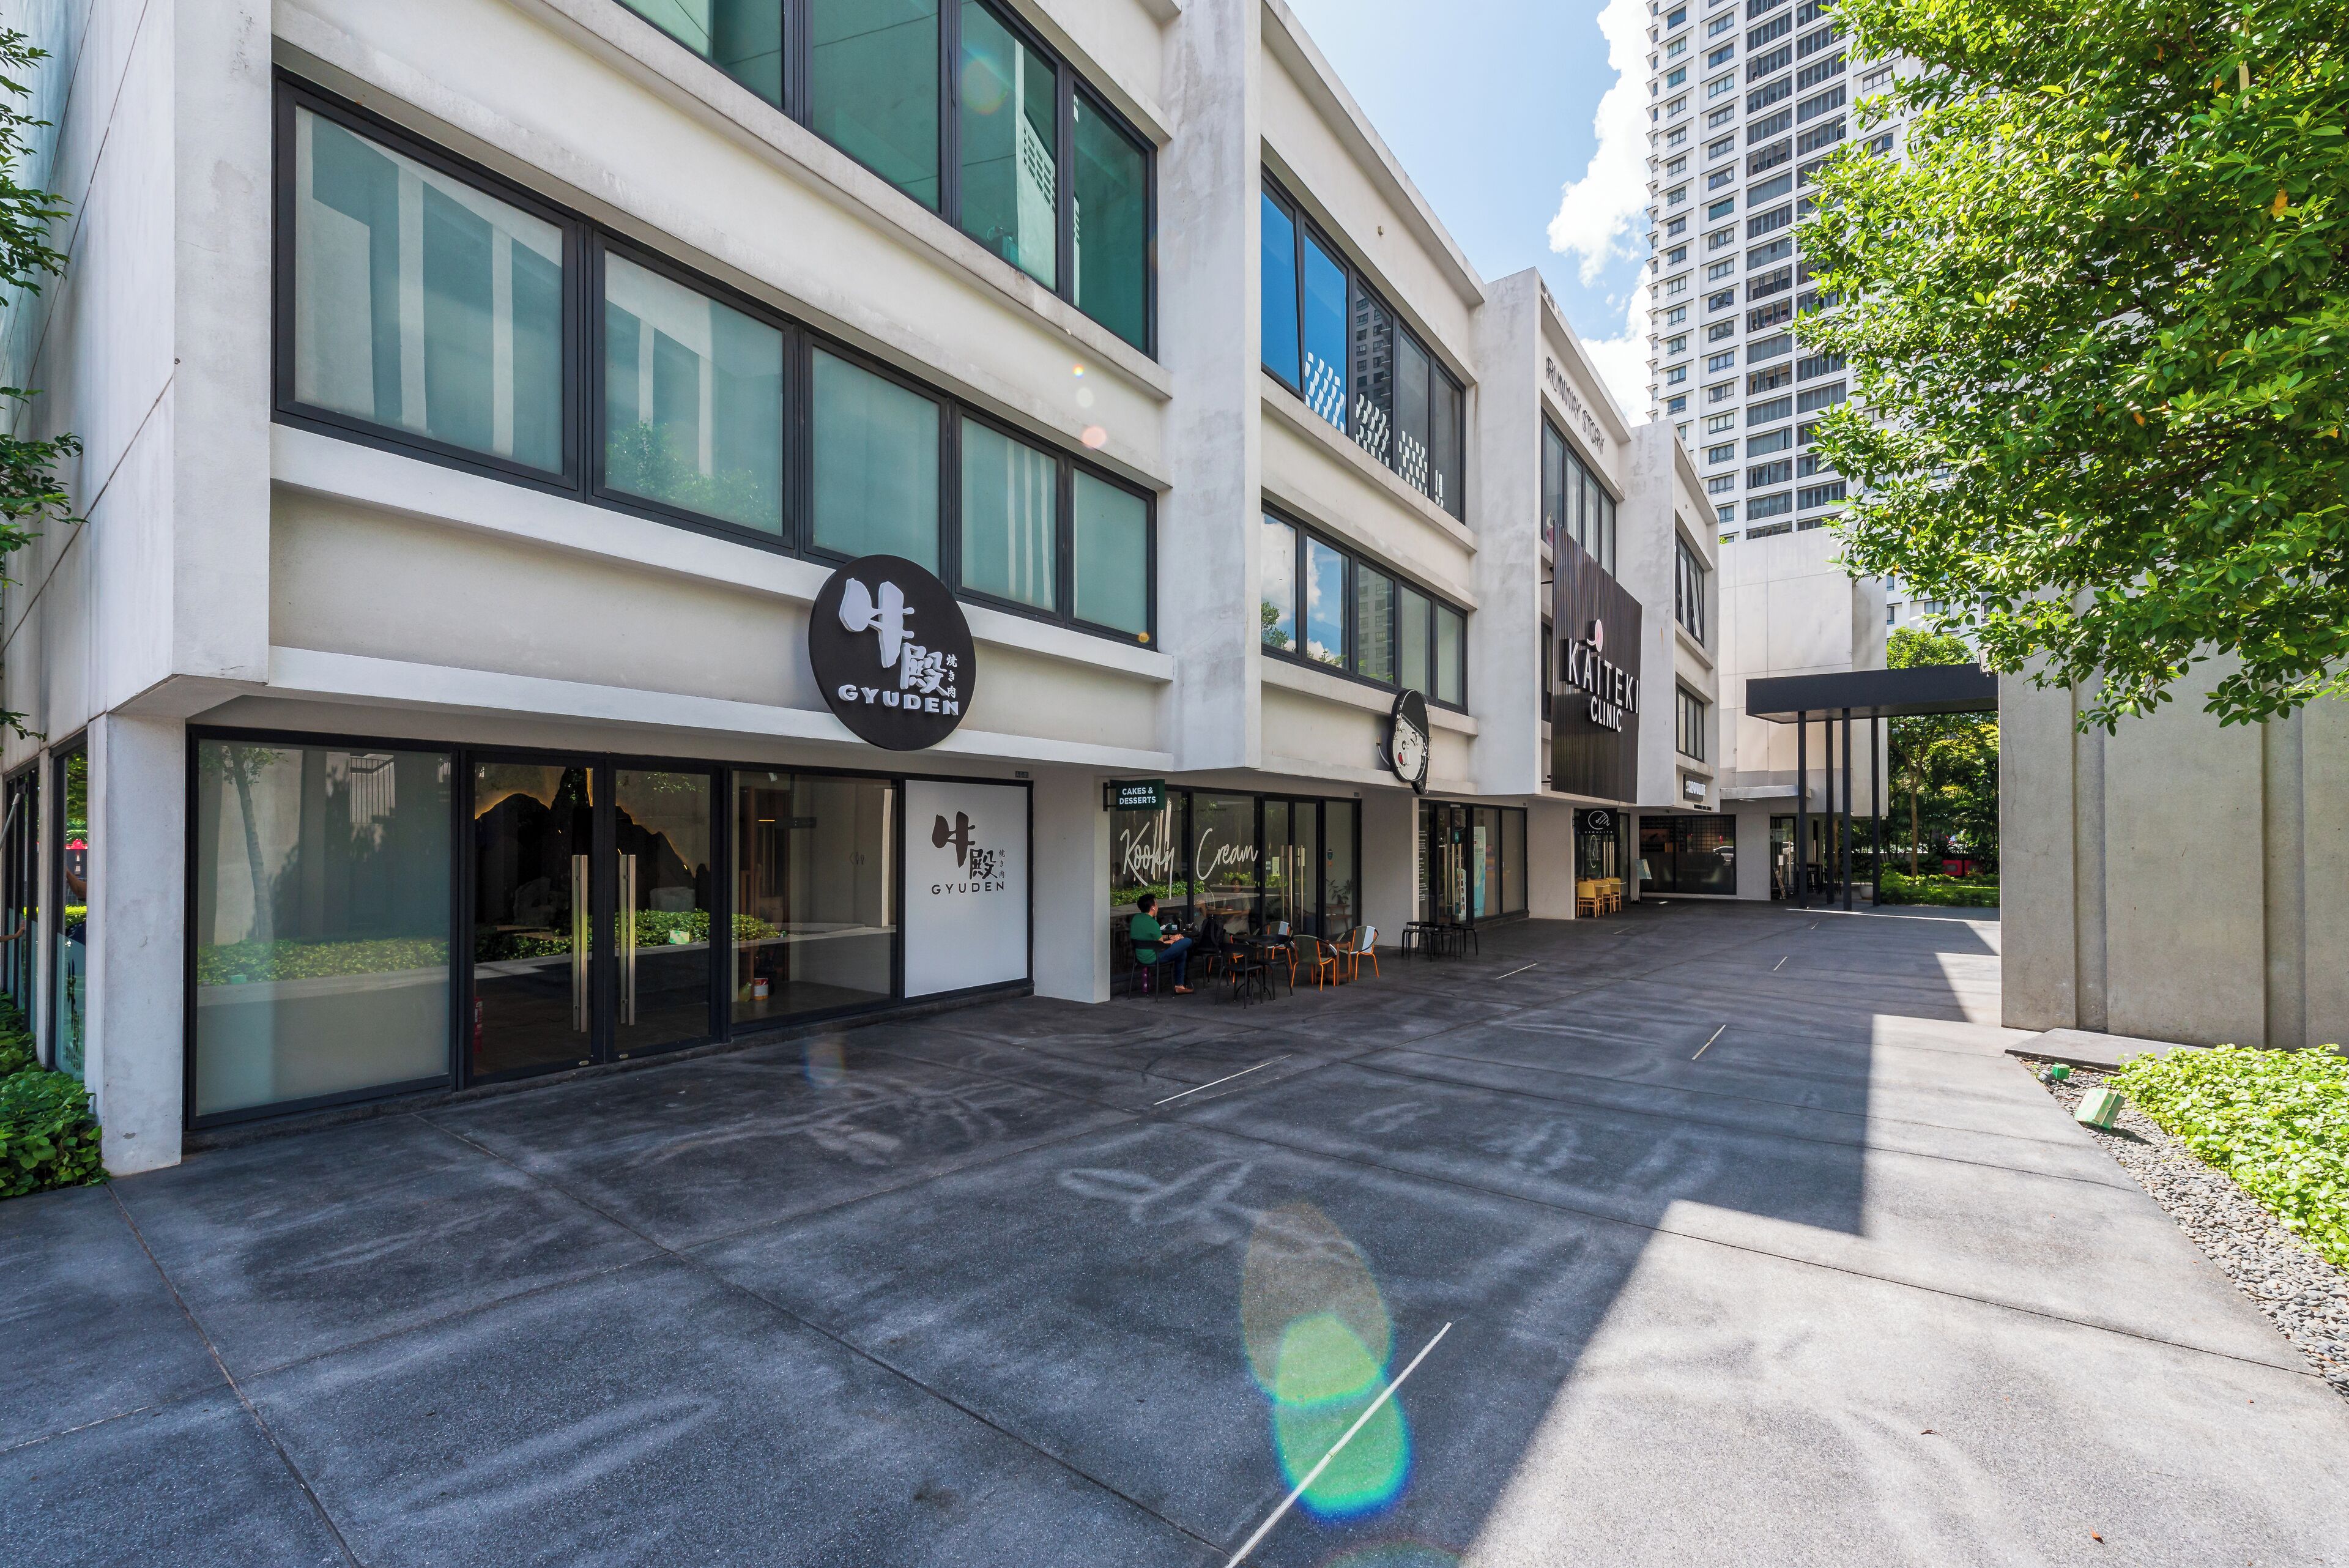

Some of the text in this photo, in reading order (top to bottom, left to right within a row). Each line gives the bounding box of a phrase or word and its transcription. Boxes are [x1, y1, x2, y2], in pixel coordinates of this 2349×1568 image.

[1546, 357, 1605, 455] RUNWAY STORY
[946, 654, 958, 698] 焼き肉
[1568, 638, 1639, 713] KAITEKI
[839, 685, 959, 715] GYUDEN
[1590, 696, 1622, 732] CLINIC
[1119, 796, 1156, 804] DESSERTS
[1196, 828, 1258, 880] Cream
[931, 881, 1004, 894] GYUDEN
